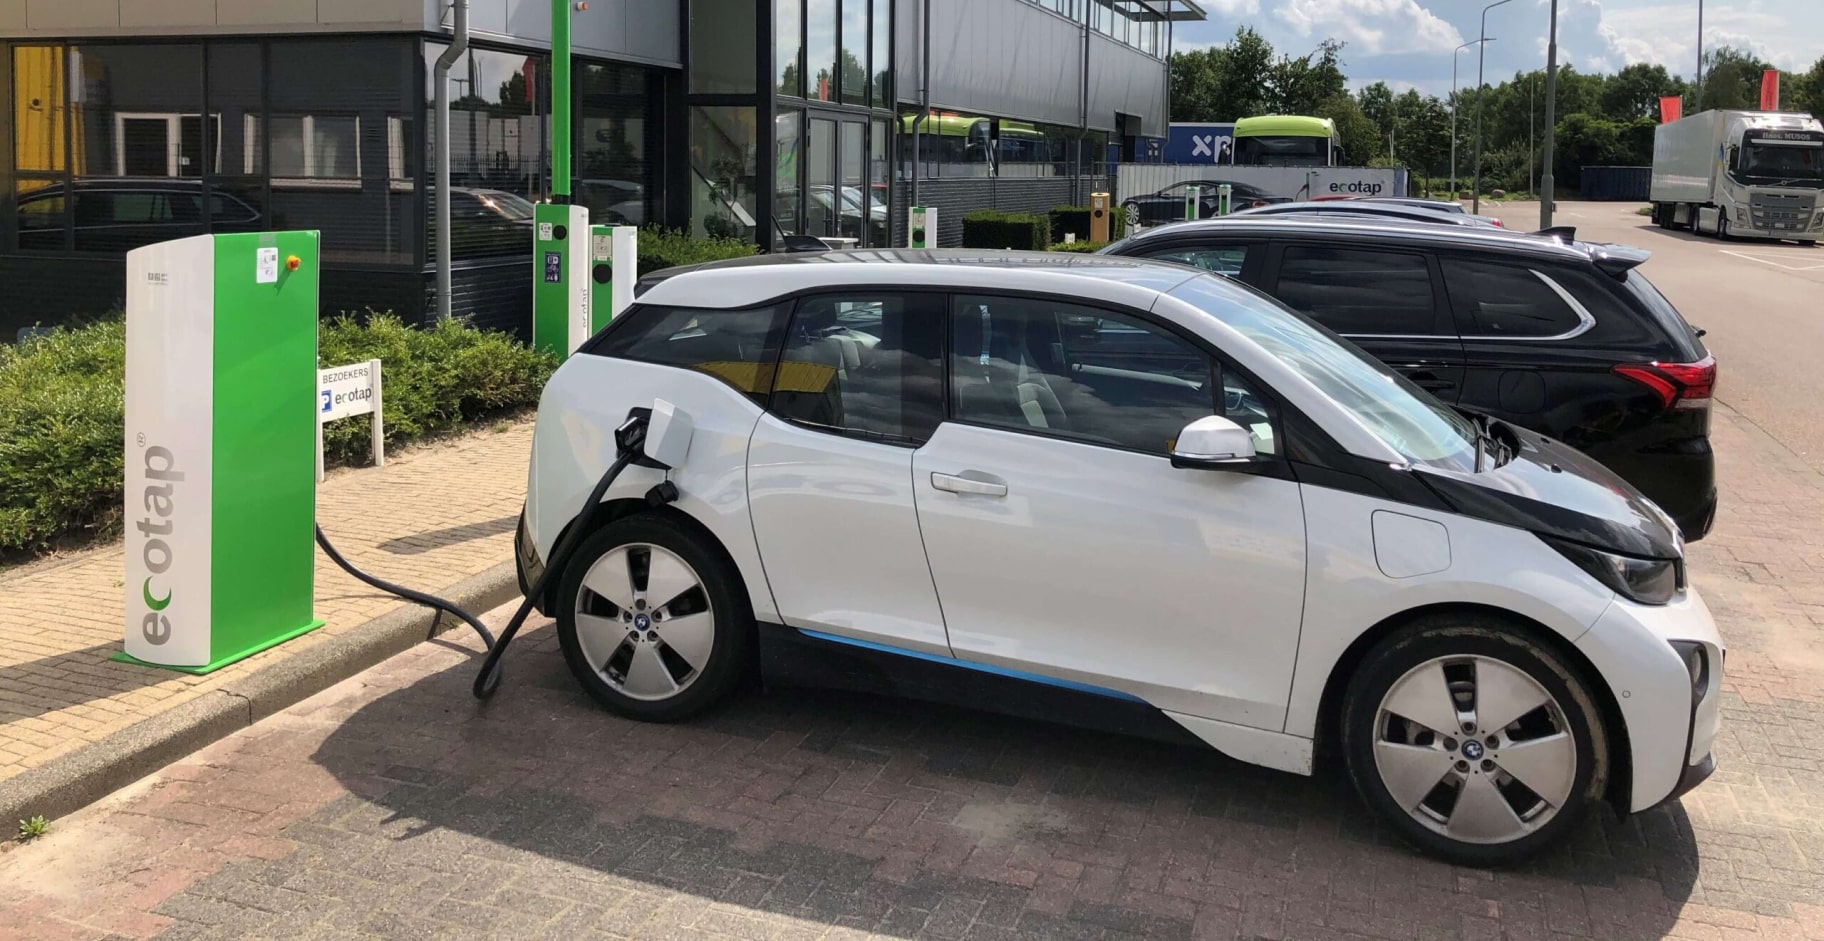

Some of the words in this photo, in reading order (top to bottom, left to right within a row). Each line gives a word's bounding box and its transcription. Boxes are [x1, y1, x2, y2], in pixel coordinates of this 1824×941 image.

[1329, 180, 1382, 196] ecotap
[322, 368, 369, 384] BEZOEKERS
[335, 387, 372, 404] ecotap
[136, 445, 185, 646] ecotap
